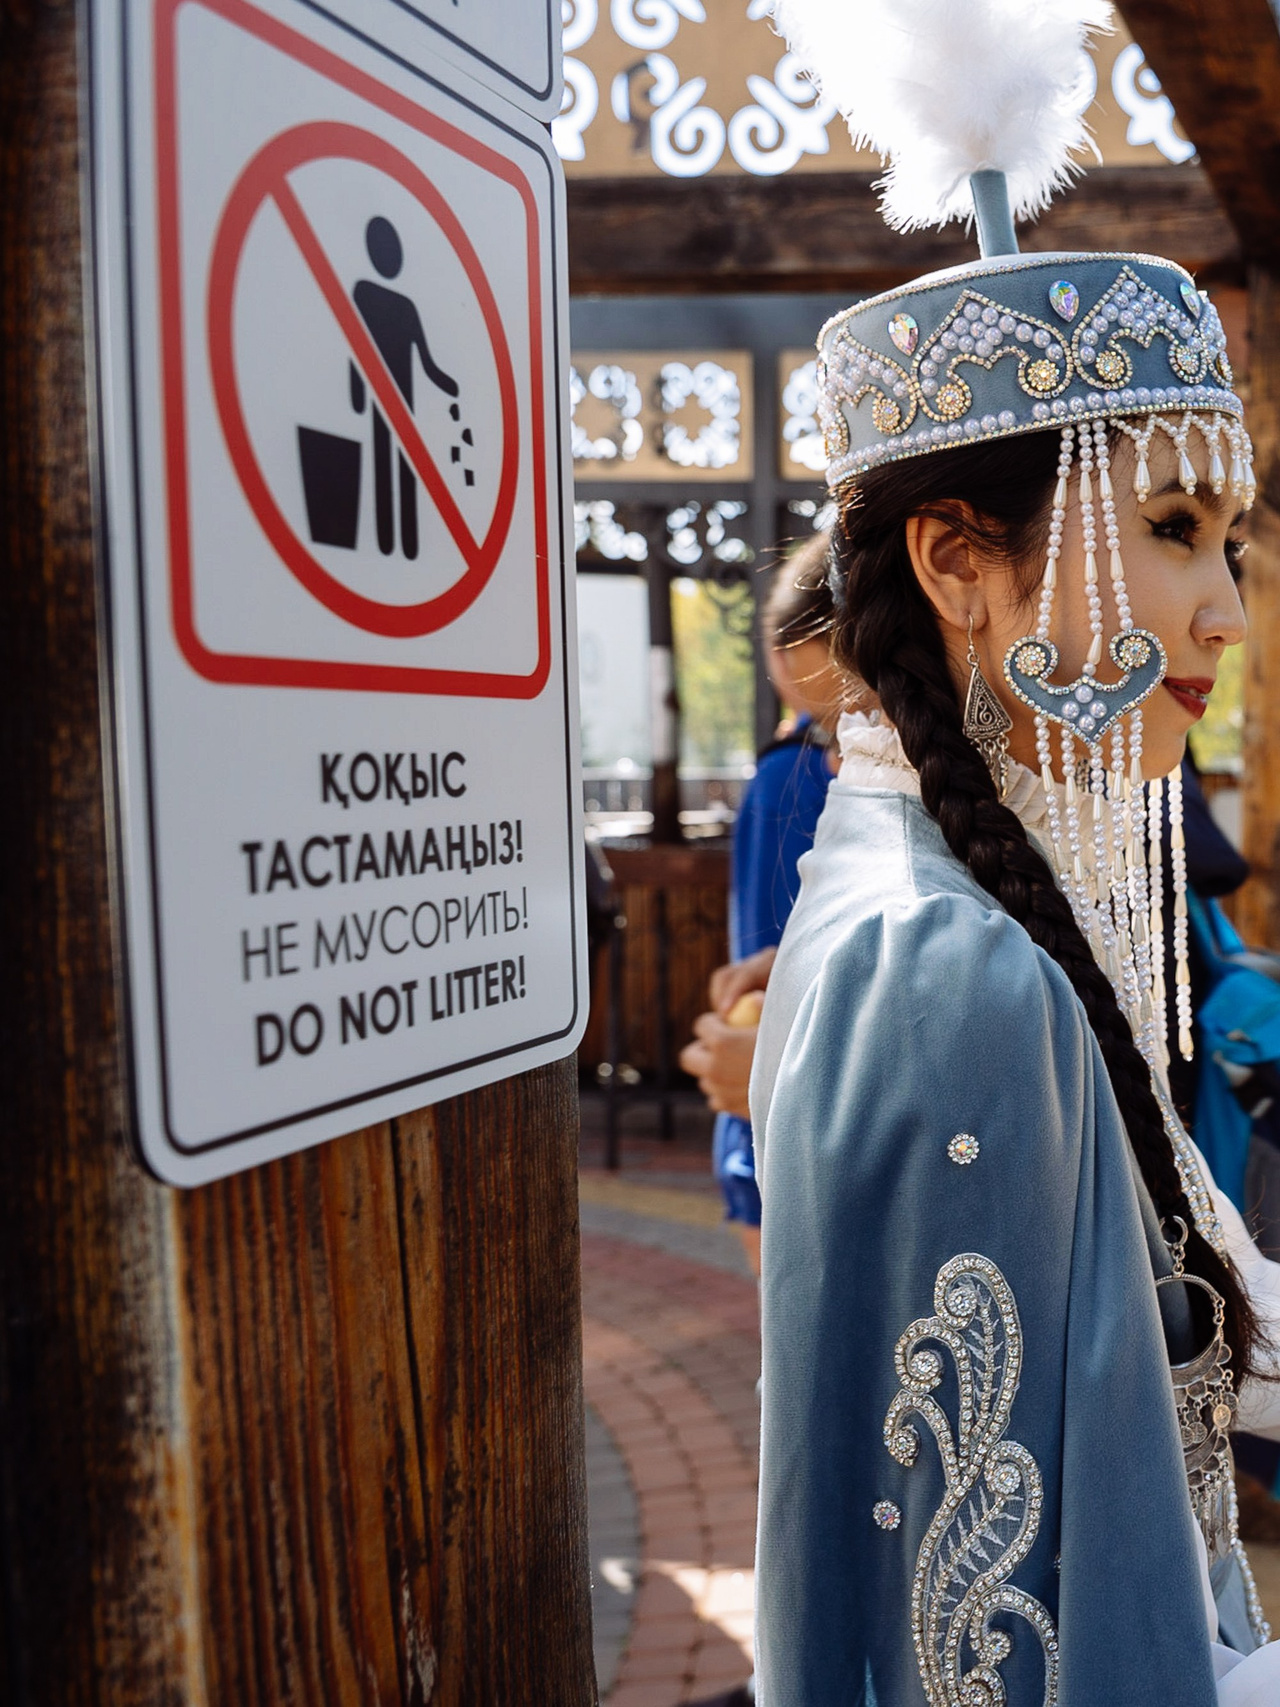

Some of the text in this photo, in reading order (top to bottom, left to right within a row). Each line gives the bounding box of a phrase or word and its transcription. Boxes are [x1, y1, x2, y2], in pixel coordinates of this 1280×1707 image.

[319, 751, 468, 810] ҚОҚЫС
[240, 819, 524, 896] ТАСТАМАҢЫЗ!
[240, 885, 529, 983] НЕ МУСОРИТЬ!
[254, 954, 528, 1068] DO NOT LITTER!
